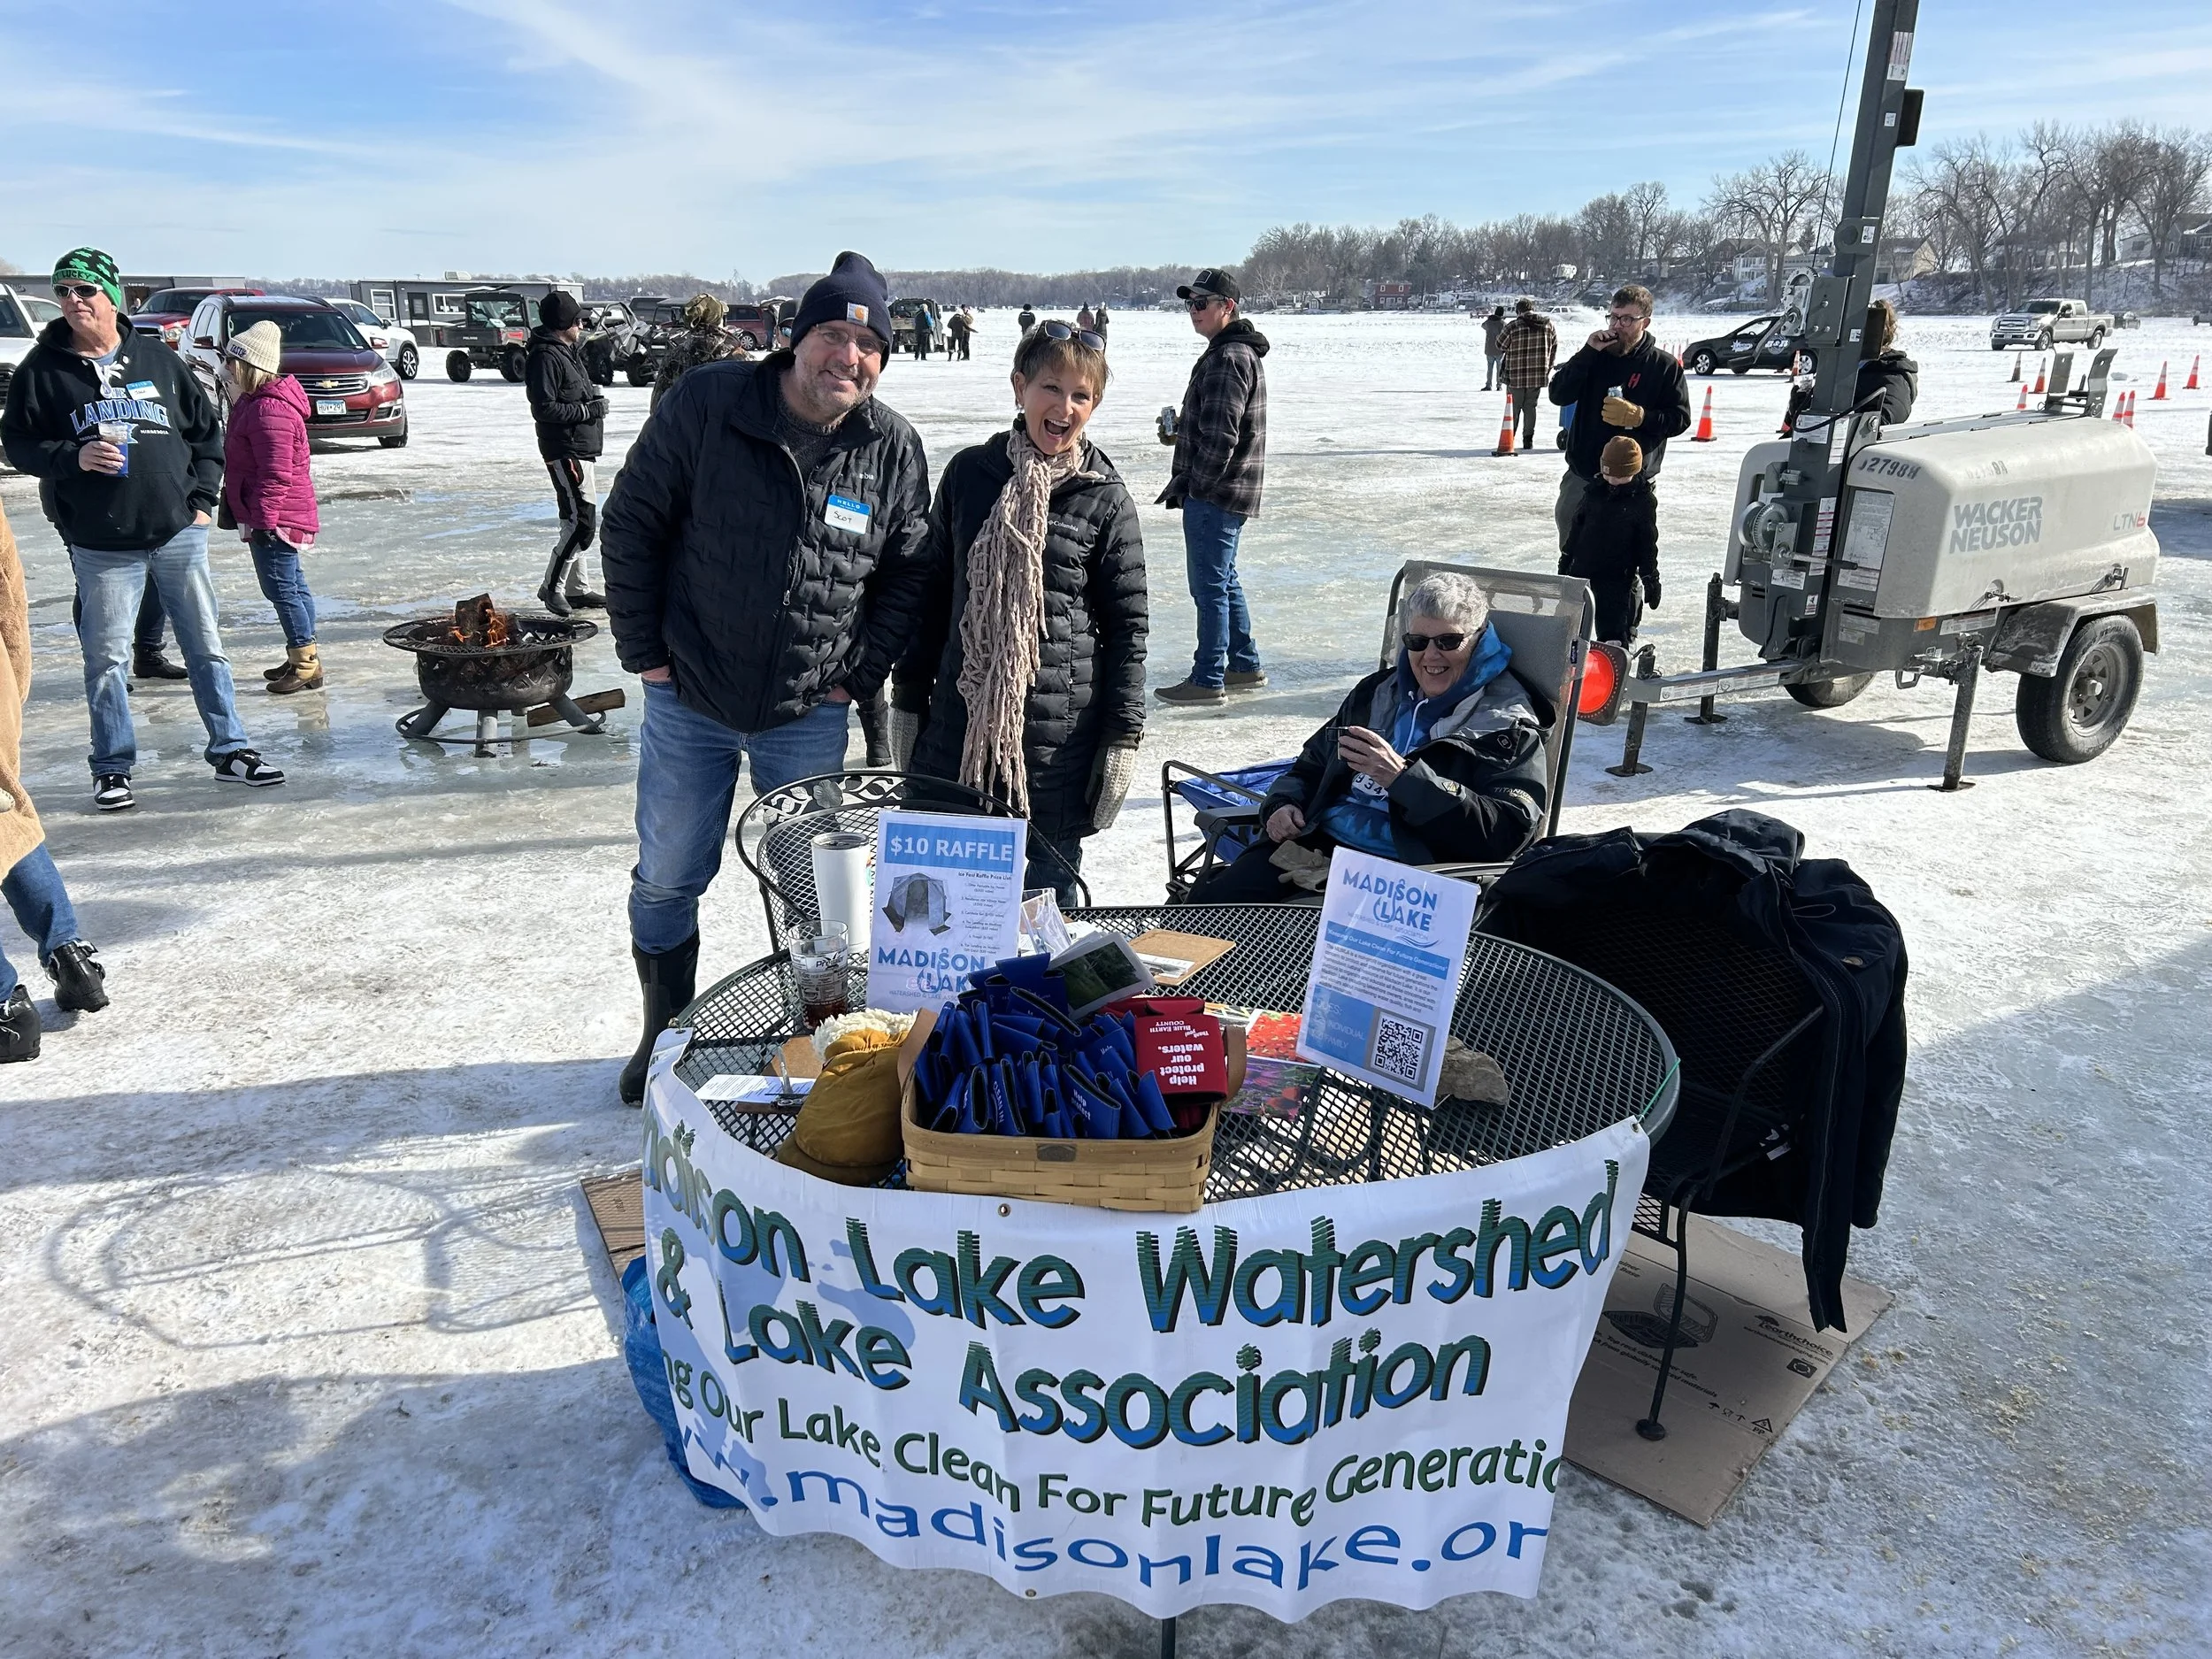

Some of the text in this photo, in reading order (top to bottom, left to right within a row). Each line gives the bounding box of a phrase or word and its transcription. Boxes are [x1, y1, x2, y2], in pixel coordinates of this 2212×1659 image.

[70, 398, 171, 435] LANDING
[837, 498, 861, 510] HELLO
[1953, 495, 2042, 528] WACKER
[1948, 518, 2042, 554] NEUSON
[890, 834, 1013, 862] $10 RAFFLE
[1342, 868, 1438, 911] MADISON
[1380, 901, 1432, 932] LAKE
[877, 946, 986, 973] MADISON
[926, 972, 971, 993] LAK
[1157, 1043, 1204, 1054] waters.
[1171, 1055, 1192, 1064] our
[1159, 1063, 1204, 1076] protect
[1169, 1075, 1197, 1086] Help
[642, 1108, 1619, 1333] adison Lake Watershed
[656, 1226, 1492, 1450] & Lake Association
[1763, 1323, 1833, 1356] earthchoice
[700, 1371, 764, 1444] Our
[778, 1397, 882, 1468] Lake
[894, 1432, 1021, 1512] Clean
[1037, 1473, 1127, 1517] For
[1141, 1483, 1317, 1527] Future
